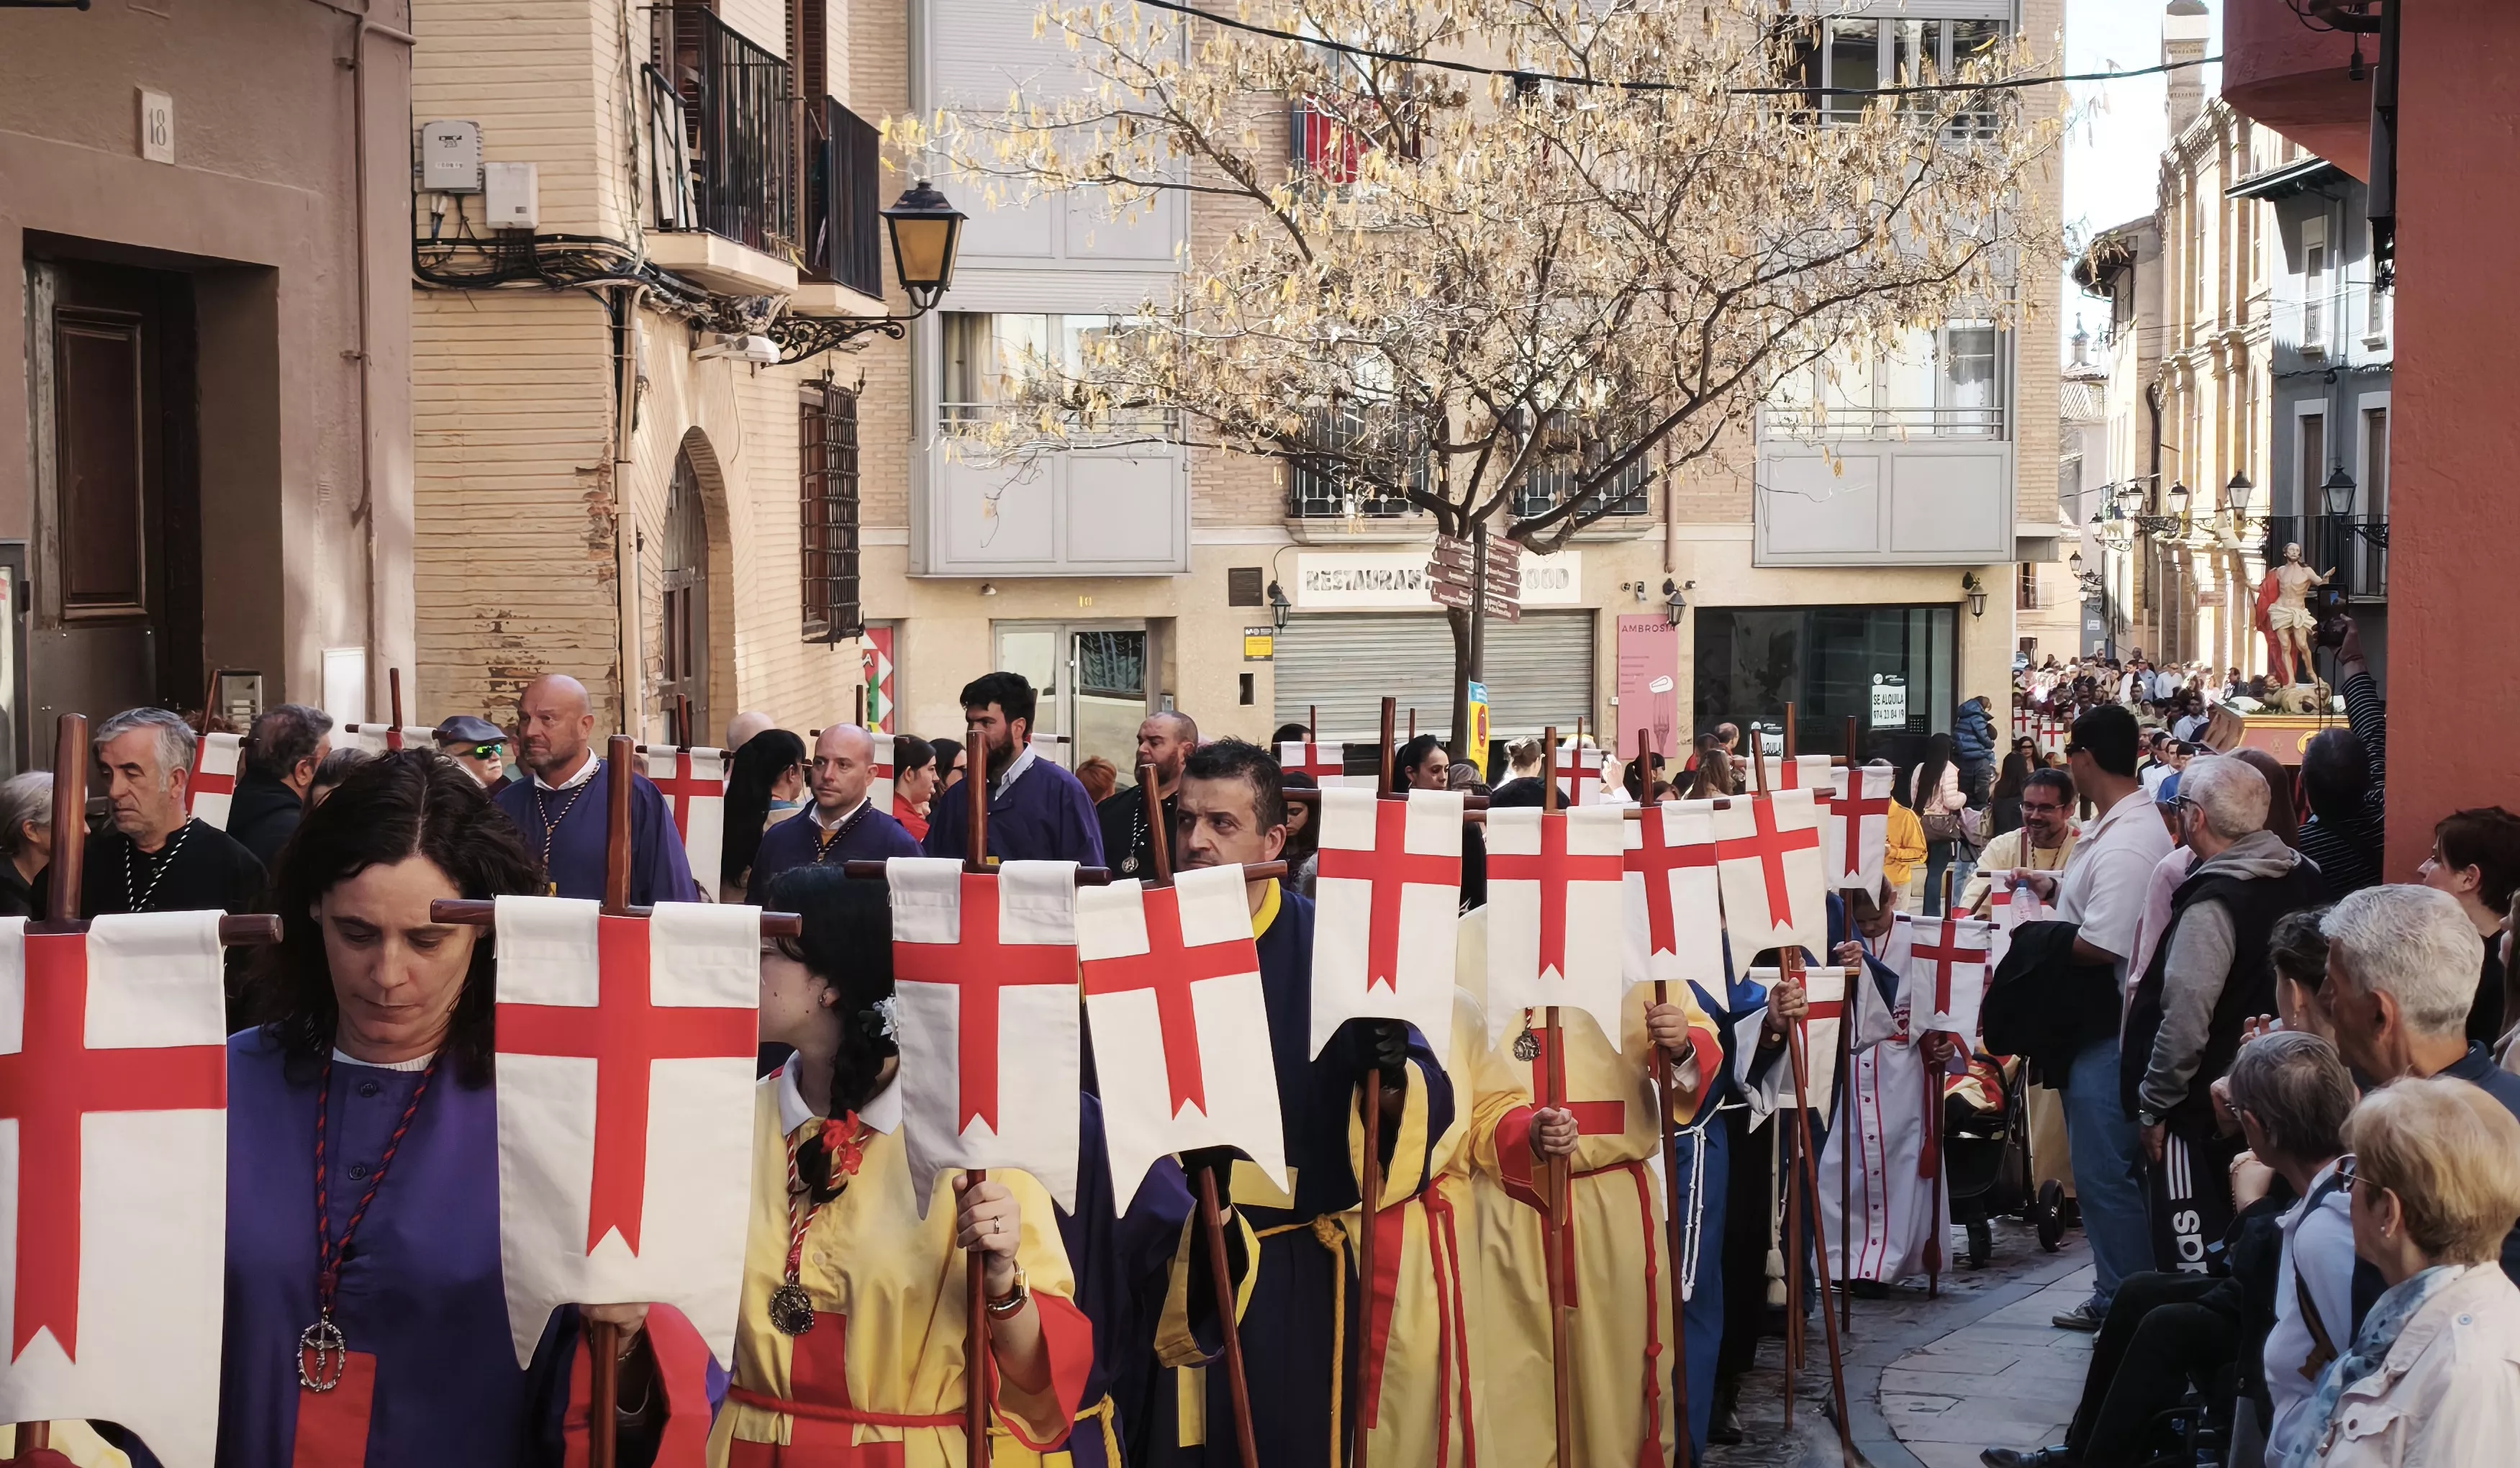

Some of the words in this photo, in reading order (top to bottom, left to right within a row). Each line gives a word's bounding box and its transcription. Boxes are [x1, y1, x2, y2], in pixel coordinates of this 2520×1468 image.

[148, 107, 167, 146] 18
[1520, 568, 1569, 589] OOD
[1079, 596, 1092, 607] 10
[1621, 624, 1676, 633] AMBROSIA
[1873, 694, 1880, 705] SE
[1882, 693, 1904, 705] ALQUILA
[1873, 710, 1882, 720] 974
